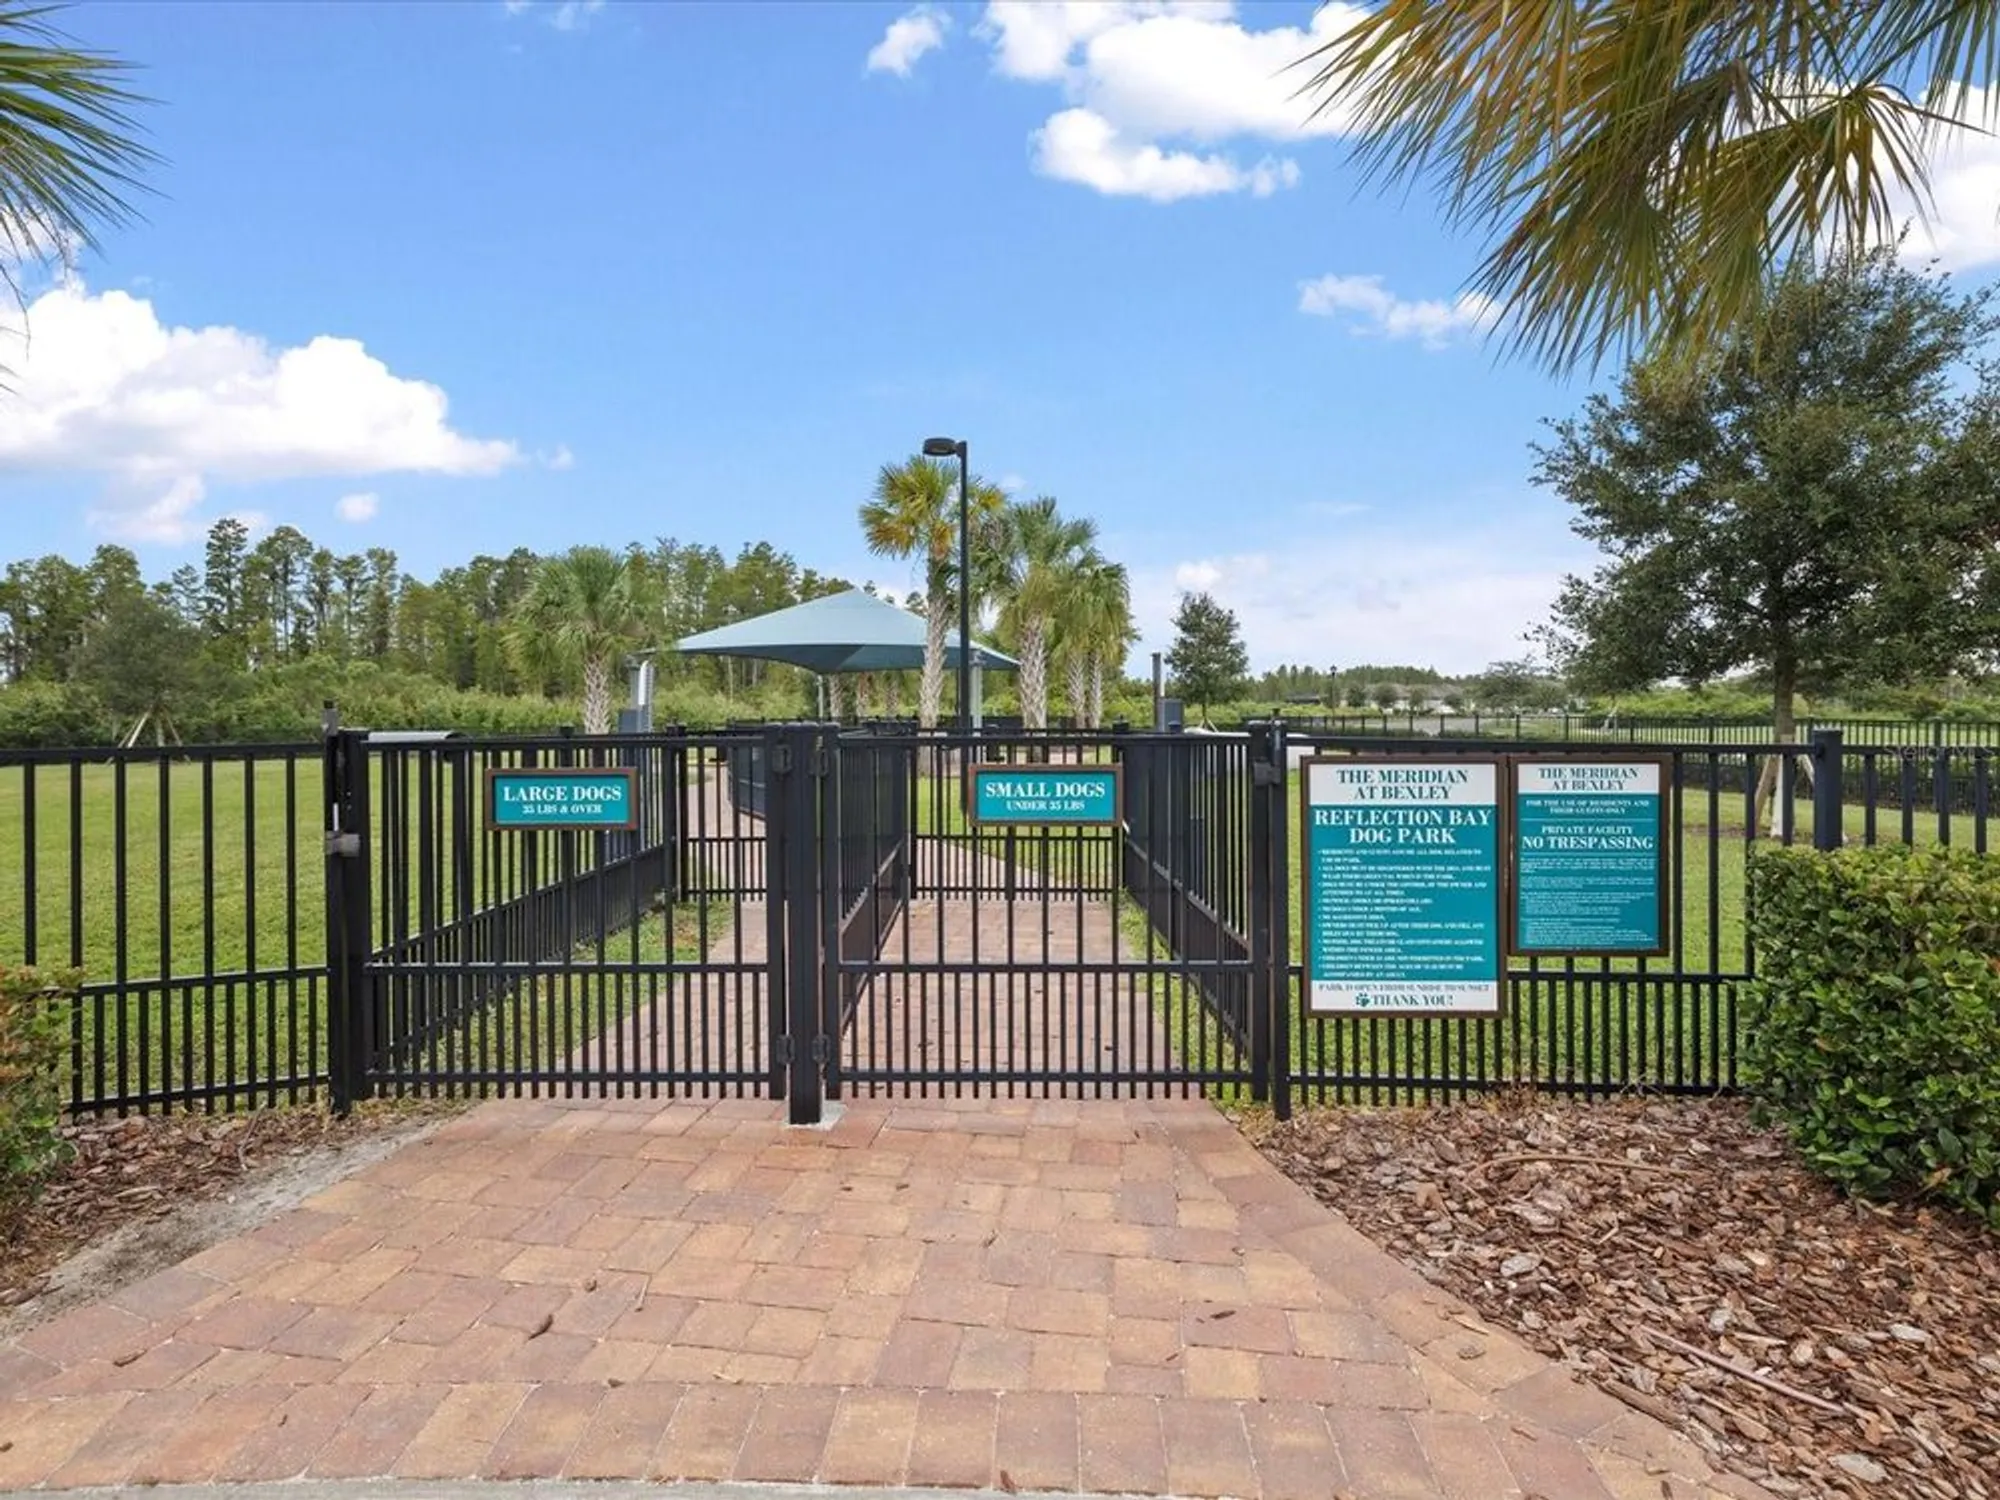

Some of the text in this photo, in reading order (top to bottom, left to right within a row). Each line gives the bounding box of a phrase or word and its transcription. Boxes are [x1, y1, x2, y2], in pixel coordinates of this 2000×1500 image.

[1337, 769, 1469, 784] THE MERIDIAN
[1538, 768, 1639, 779] THE MERIDIAN
[985, 782, 1106, 798] SMALL DOGS
[1552, 780, 1626, 791] AT BEXLEY
[503, 786, 622, 801] LARGE DOGS
[1355, 786, 1452, 800] AT BEXLEY
[522, 804, 603, 815] 35 LBS & OVER
[1006, 800, 1086, 811] UNDER 35 LBS
[1314, 809, 1492, 826] REFLECTION BAY
[1350, 828, 1457, 844] DOG PARK
[1541, 826, 1634, 835] PRIVATE FACILITY
[1522, 836, 1654, 849] NO TRESPASSING
[1318, 984, 1343, 992] PARK
[1372, 994, 1454, 1007] THANK YOU!
